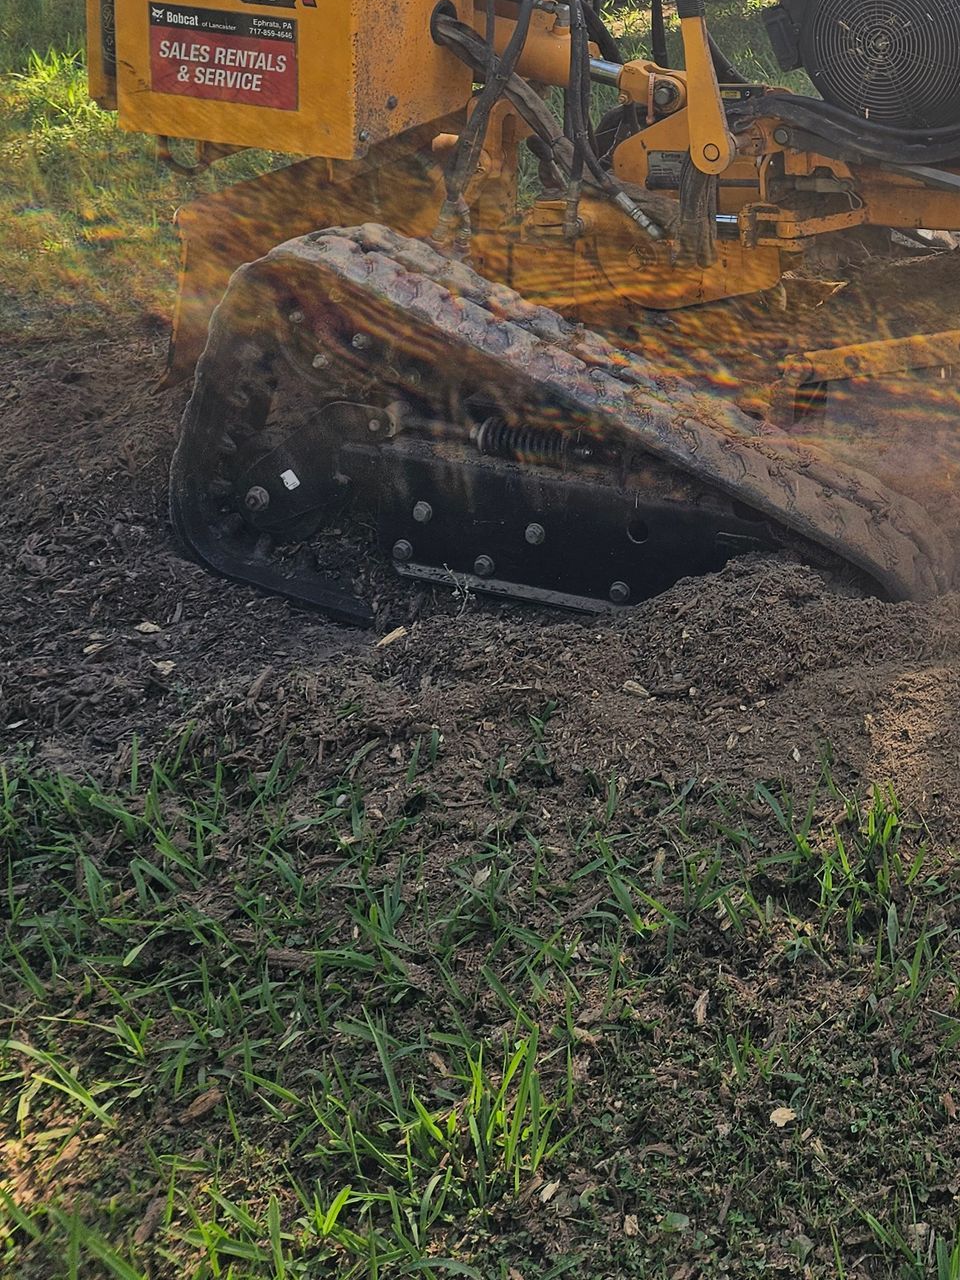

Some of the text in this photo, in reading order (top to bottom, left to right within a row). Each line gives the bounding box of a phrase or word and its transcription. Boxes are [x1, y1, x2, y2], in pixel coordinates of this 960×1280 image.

[166, 11, 199, 26] Bobcat
[208, 21, 236, 31] Lancaster
[282, 22, 292, 30] PA
[249, 27, 293, 39] 717-859-4646
[159, 40, 287, 73] SALES RENTALS
[177, 65, 263, 92] & SERVICE
